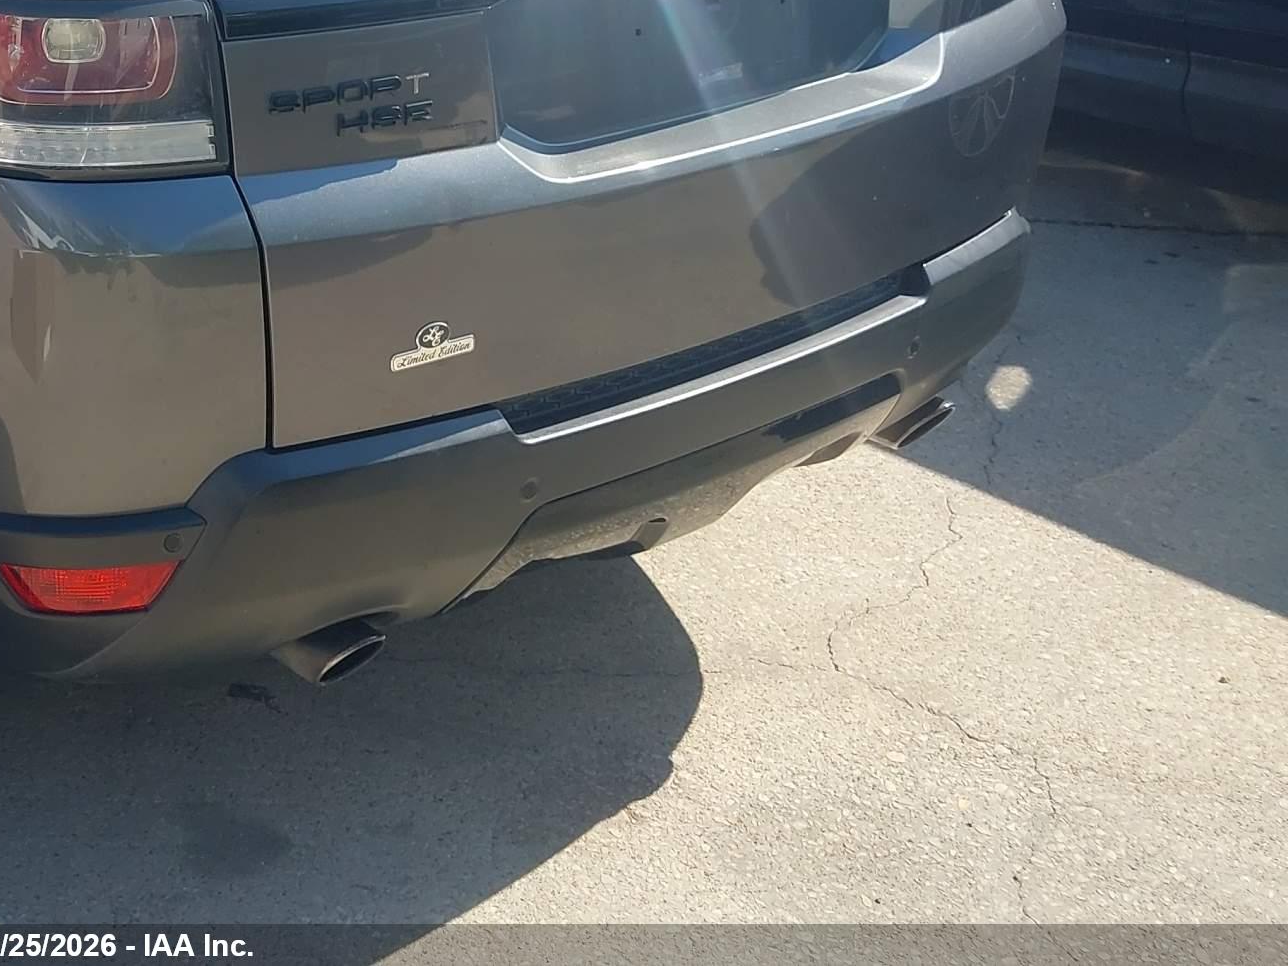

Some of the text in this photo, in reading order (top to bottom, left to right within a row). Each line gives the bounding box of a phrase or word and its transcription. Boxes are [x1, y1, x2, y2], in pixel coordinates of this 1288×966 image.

[335, 100, 433, 137] HSE
[396, 341, 471, 369] Limited Edition
